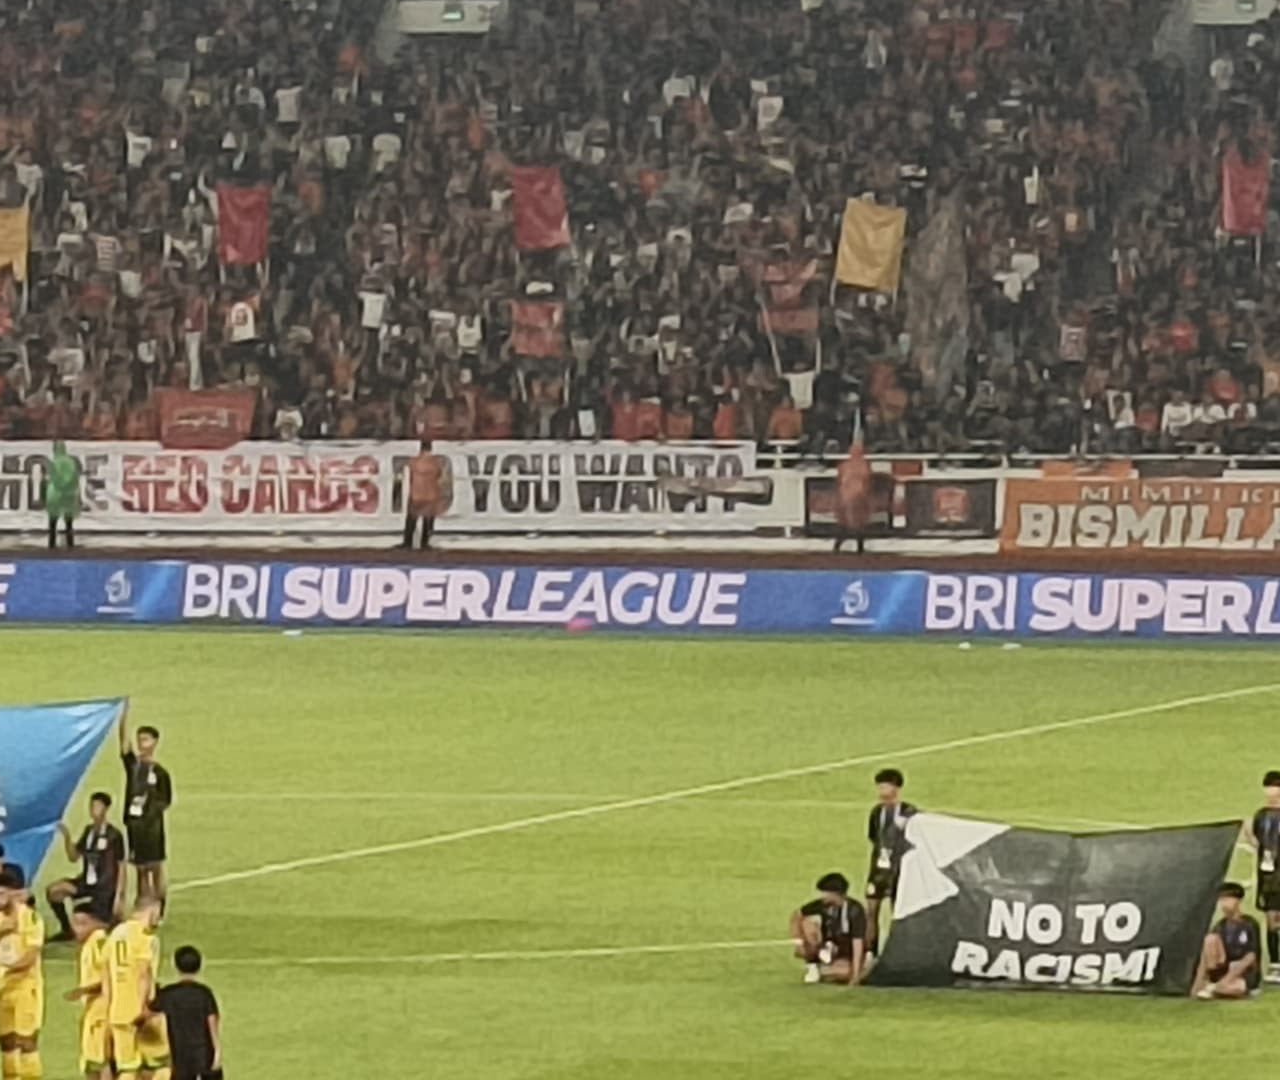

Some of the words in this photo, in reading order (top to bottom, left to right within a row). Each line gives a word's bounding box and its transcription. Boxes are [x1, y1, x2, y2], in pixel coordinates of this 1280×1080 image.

[221, 454, 380, 515] CARDS
[467, 453, 561, 514] YOU
[183, 563, 270, 619] BRI
[925, 574, 1017, 631] BRI
[986, 897, 1064, 944] NO
[1074, 899, 1142, 945] TO
[949, 940, 1161, 987] RACISM!
